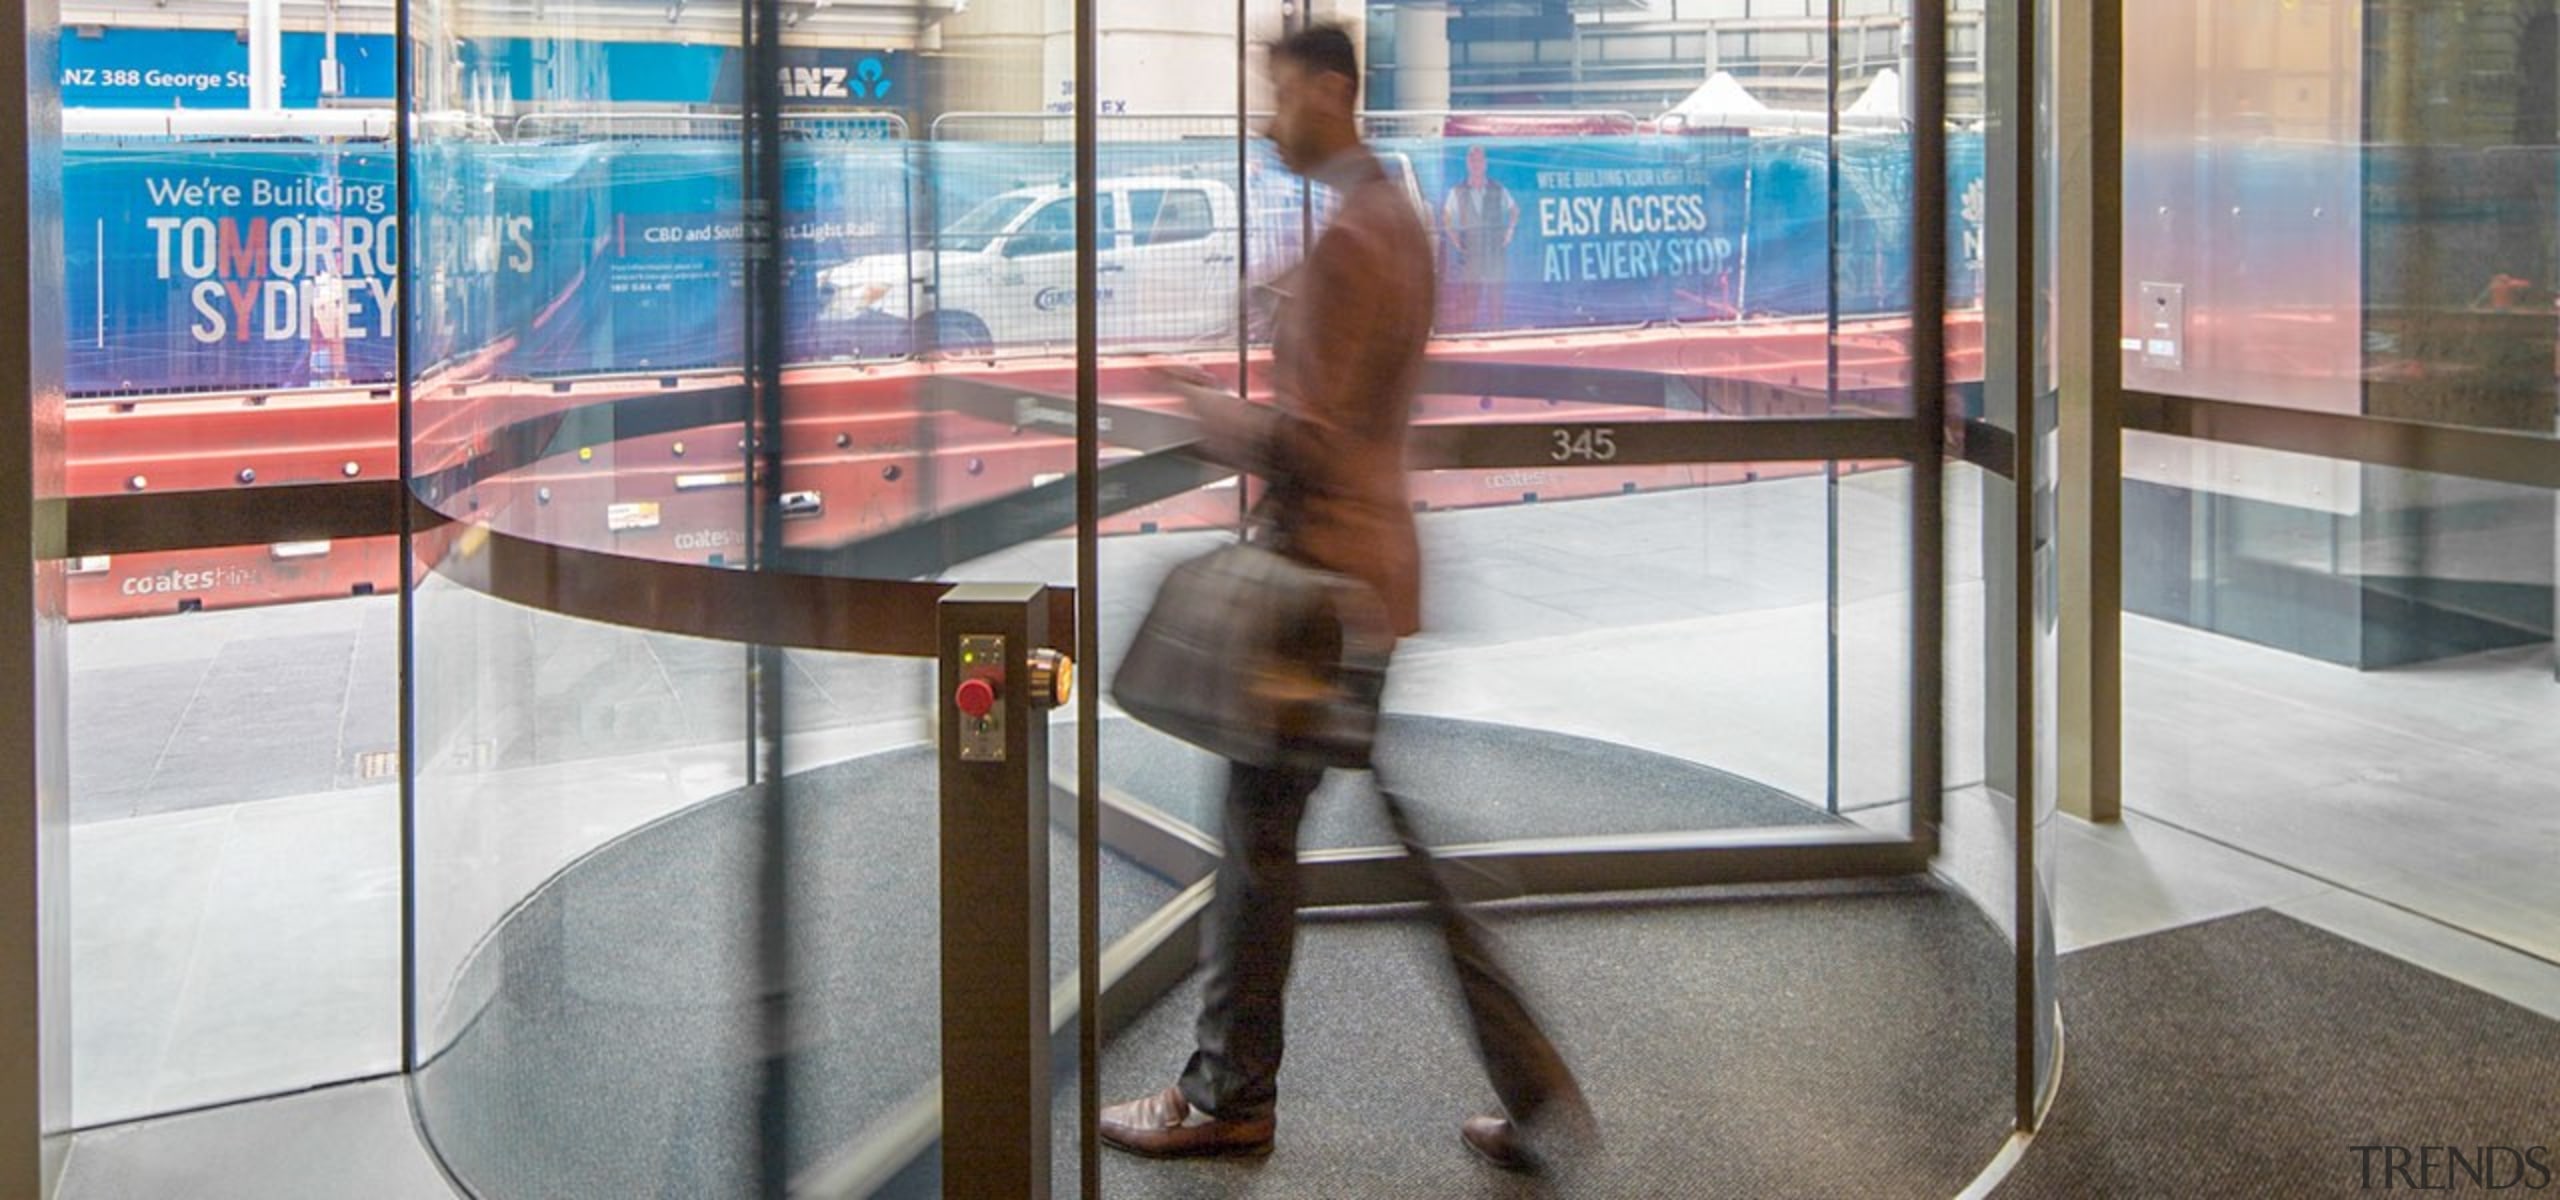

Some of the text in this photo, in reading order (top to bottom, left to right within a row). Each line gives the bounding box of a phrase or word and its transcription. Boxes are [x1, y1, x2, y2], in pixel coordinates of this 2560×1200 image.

[61, 69, 96, 86] NZ
[101, 70, 140, 87] 388
[145, 70, 221, 91] George
[146, 177, 386, 214] We're Building
[1541, 195, 1707, 237] EASY ACCESS
[644, 227, 682, 243] CBD
[686, 226, 711, 241] and
[1543, 242, 1573, 282] AT
[1581, 239, 1662, 281] EVERY
[1550, 429, 1616, 461] 345
